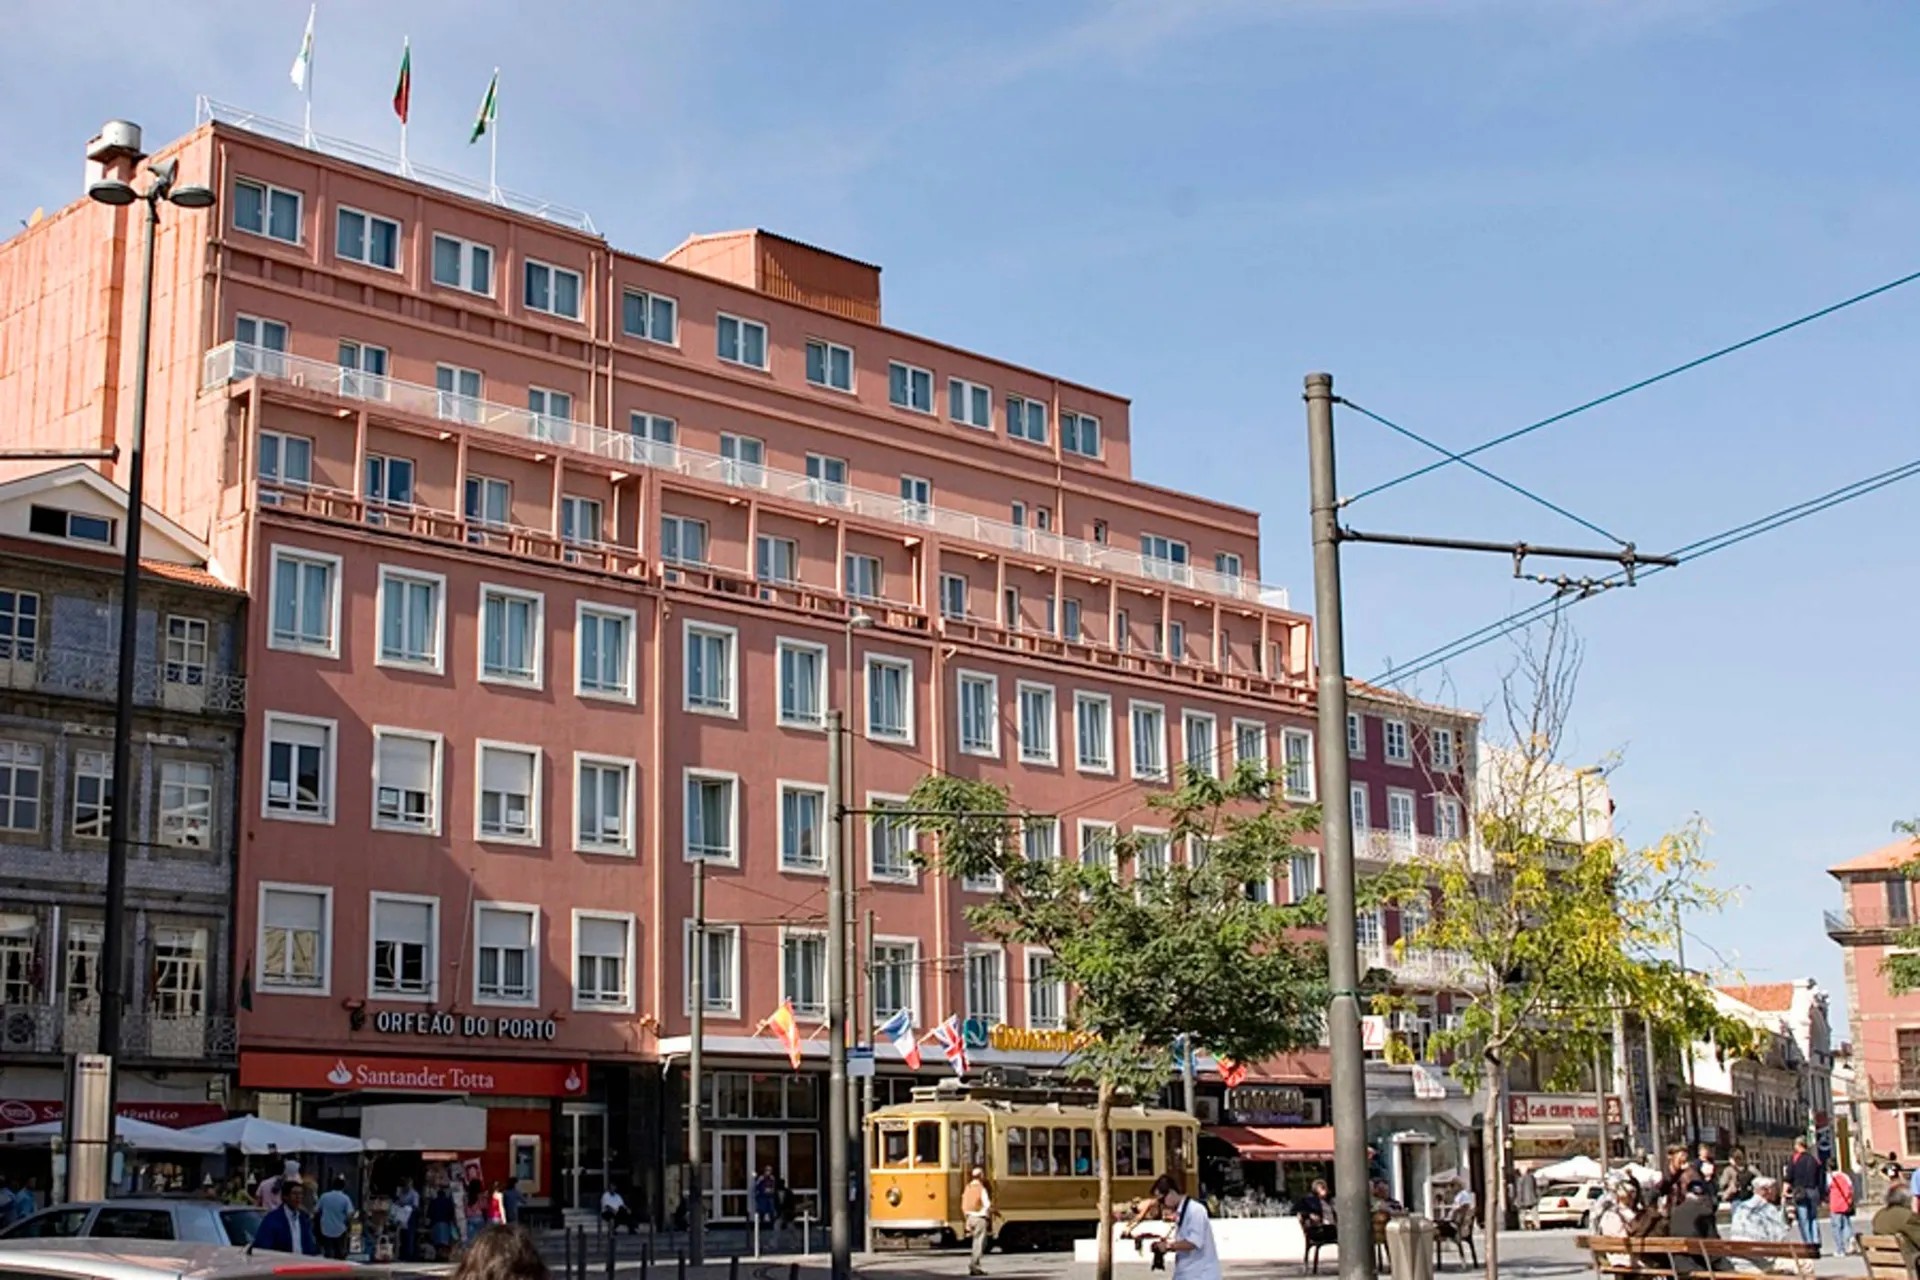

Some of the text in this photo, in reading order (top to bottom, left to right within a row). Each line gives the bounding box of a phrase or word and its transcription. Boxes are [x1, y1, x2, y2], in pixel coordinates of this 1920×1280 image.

[377, 1010, 556, 1039] ORFEÃO DO PORTO
[356, 1064, 494, 1088] Santander Totta
